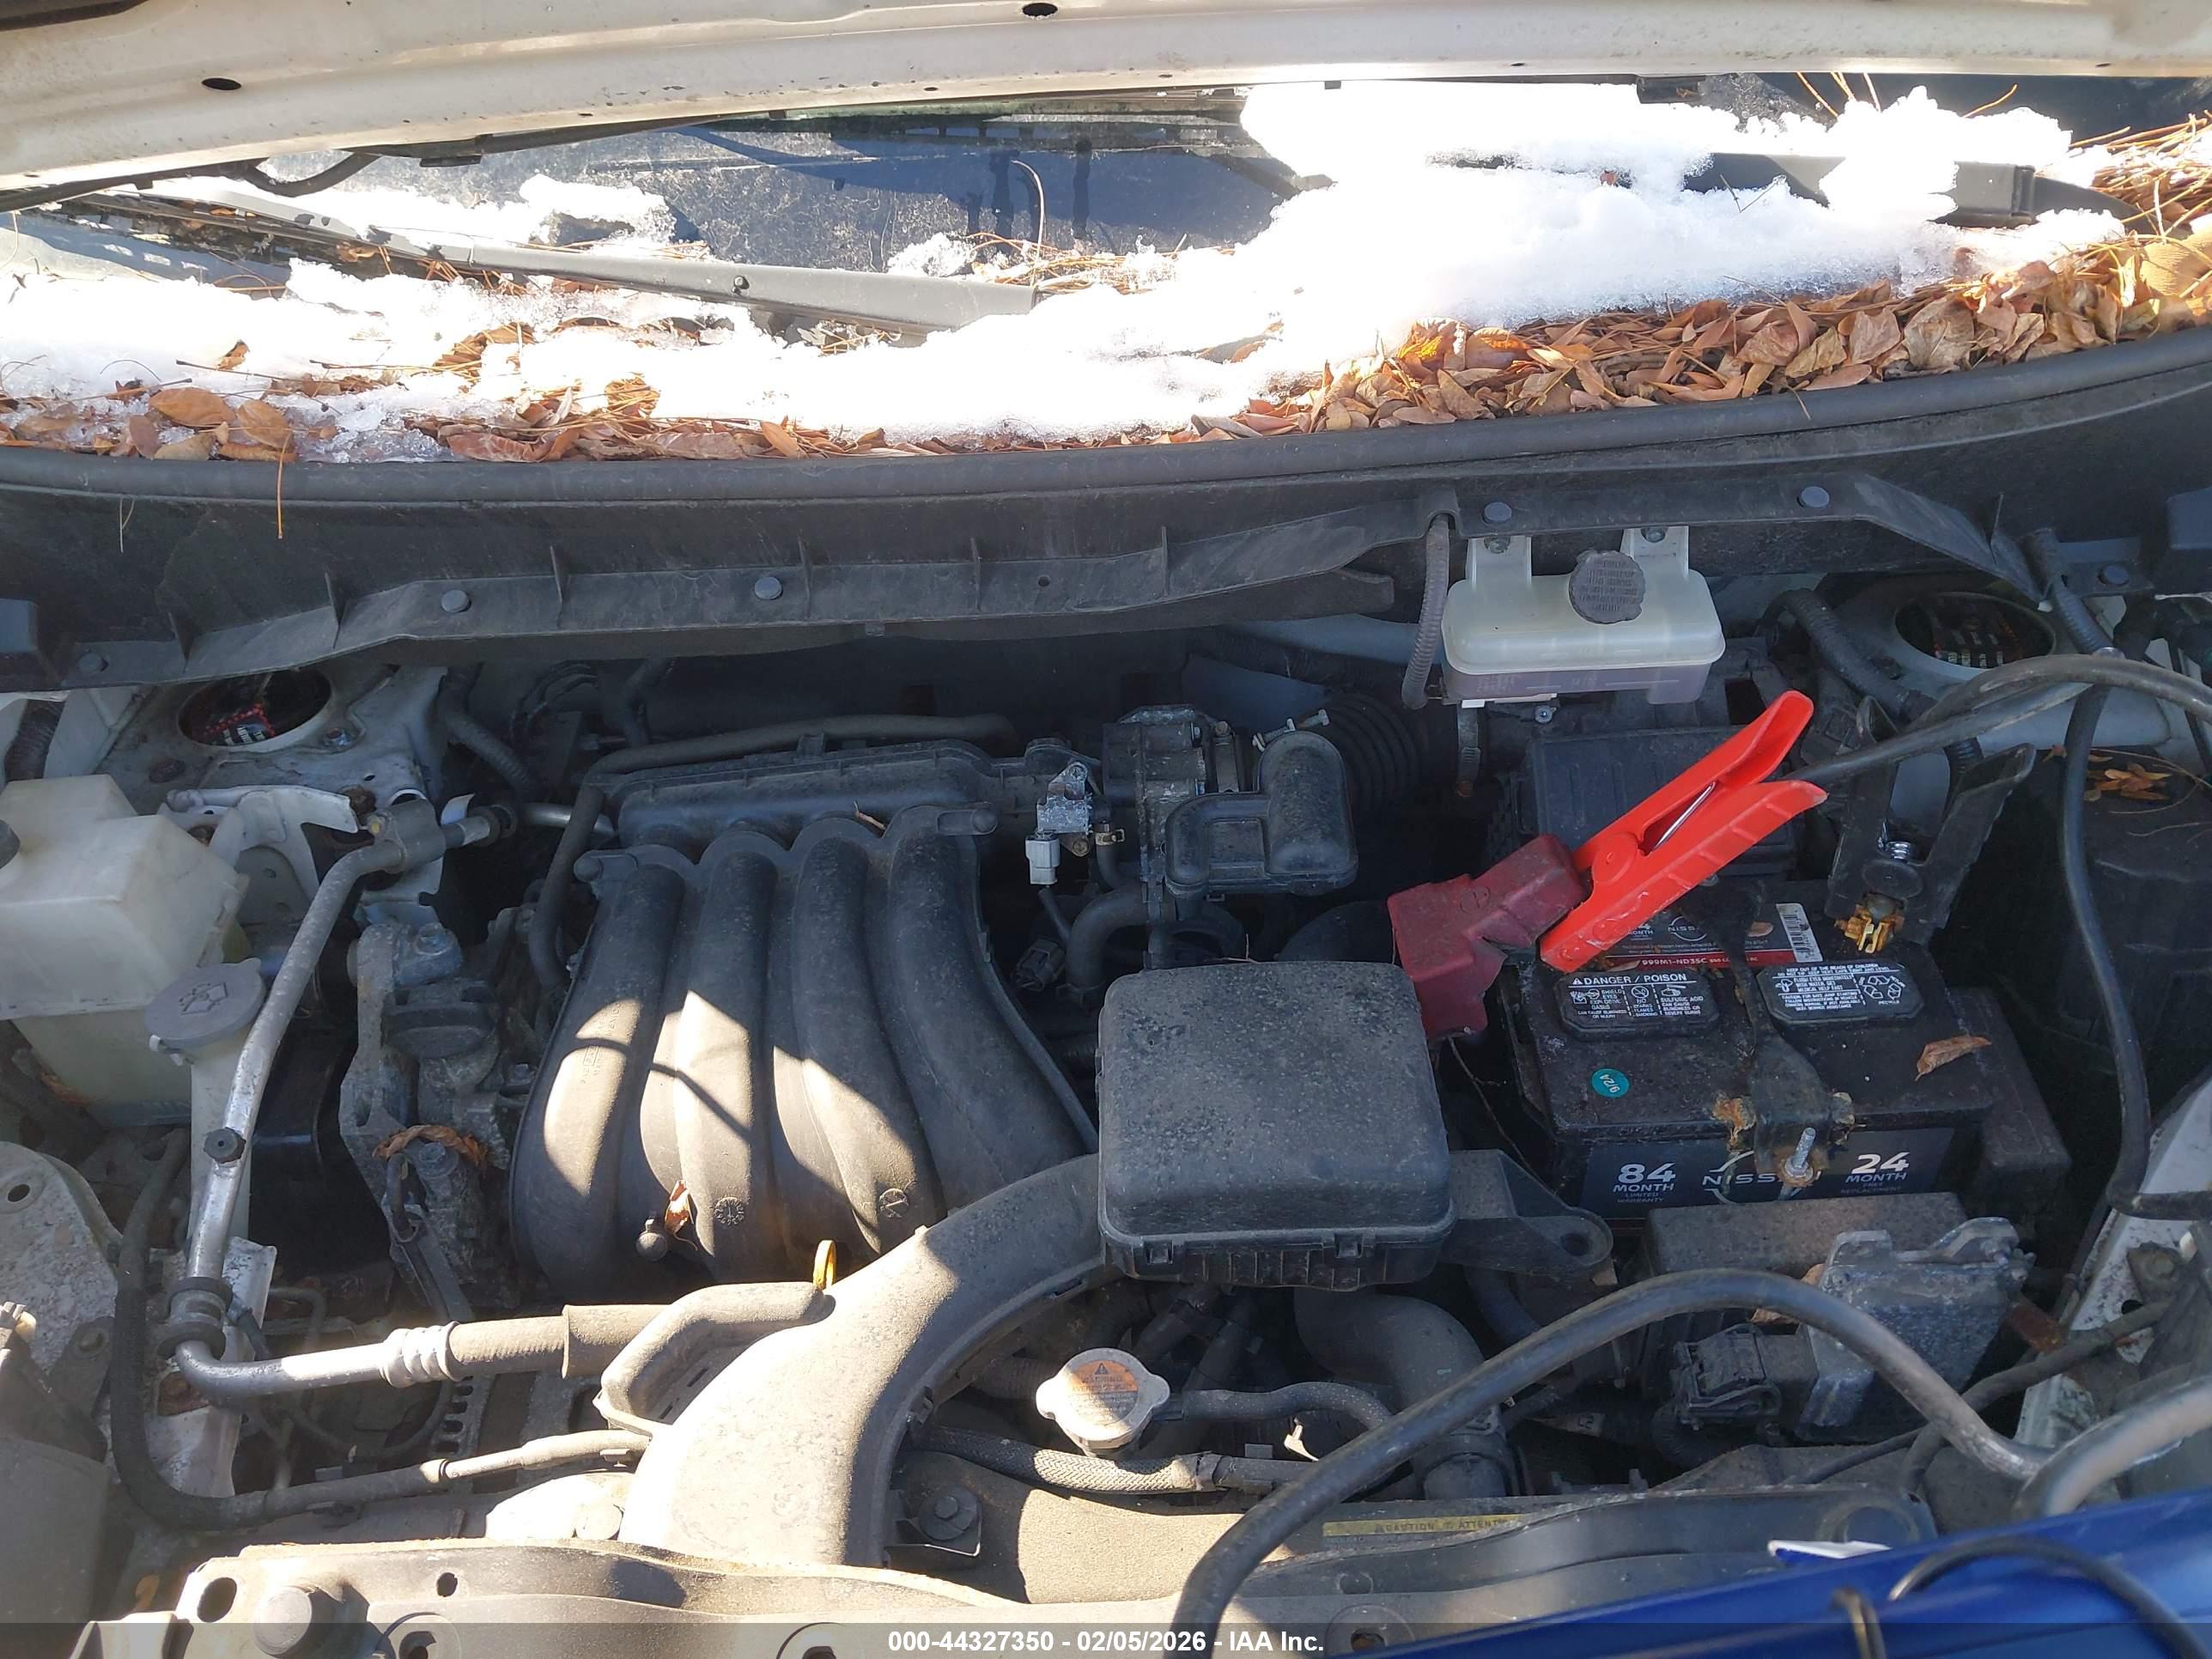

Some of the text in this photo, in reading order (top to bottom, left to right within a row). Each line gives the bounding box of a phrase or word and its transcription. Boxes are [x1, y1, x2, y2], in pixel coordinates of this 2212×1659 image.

[1583, 976, 1632, 986] DANGER
[1644, 973, 1687, 982] POISON
[1599, 1073, 1621, 1093] 9/24
[1850, 1152, 1911, 1174] 24
[1618, 1162, 1676, 1183] 84
[1845, 1172, 1908, 1183] MONTH
[1613, 1183, 1674, 1193] MONTH
[1386, 1522, 1435, 1532] CAUTION
